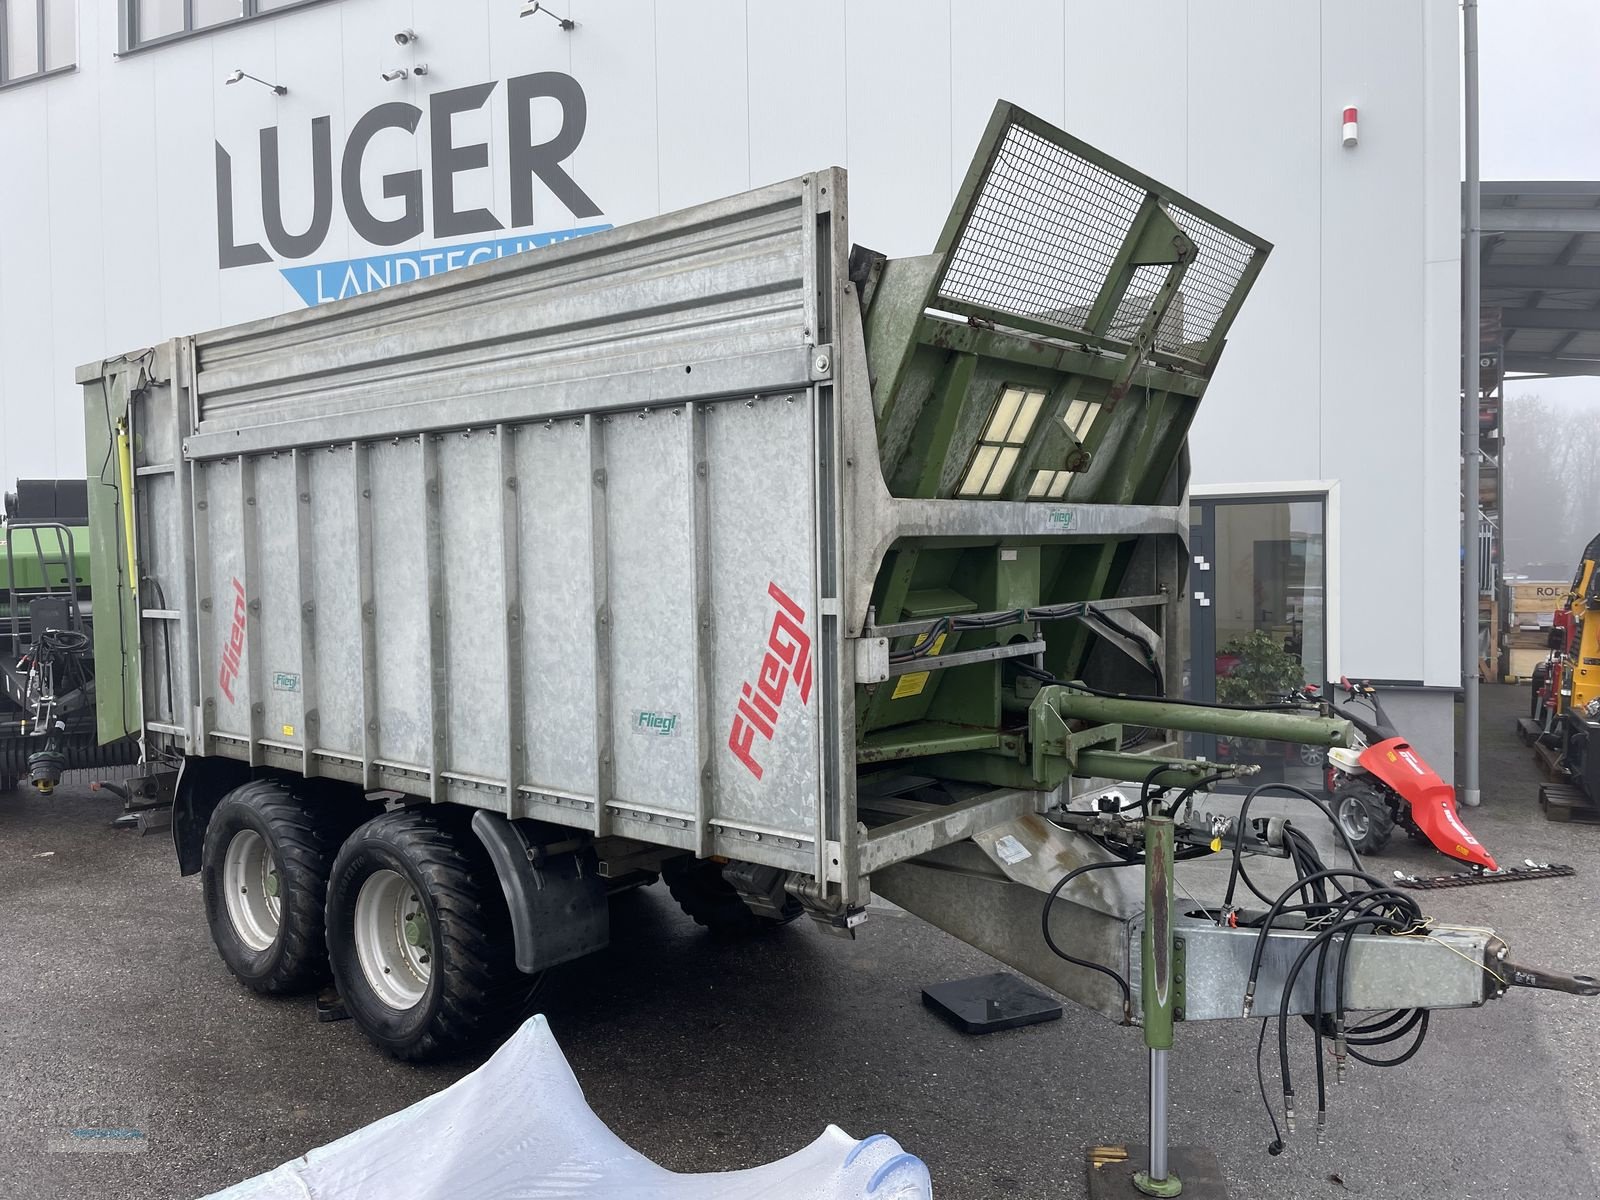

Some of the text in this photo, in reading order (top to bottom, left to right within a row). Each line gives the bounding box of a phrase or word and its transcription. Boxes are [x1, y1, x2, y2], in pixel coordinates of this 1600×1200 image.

[215, 71, 605, 269] LUGER
[316, 234, 582, 303] LANDTEC
[638, 712, 677, 736] Fliegl
[728, 581, 813, 781] Fliegl
